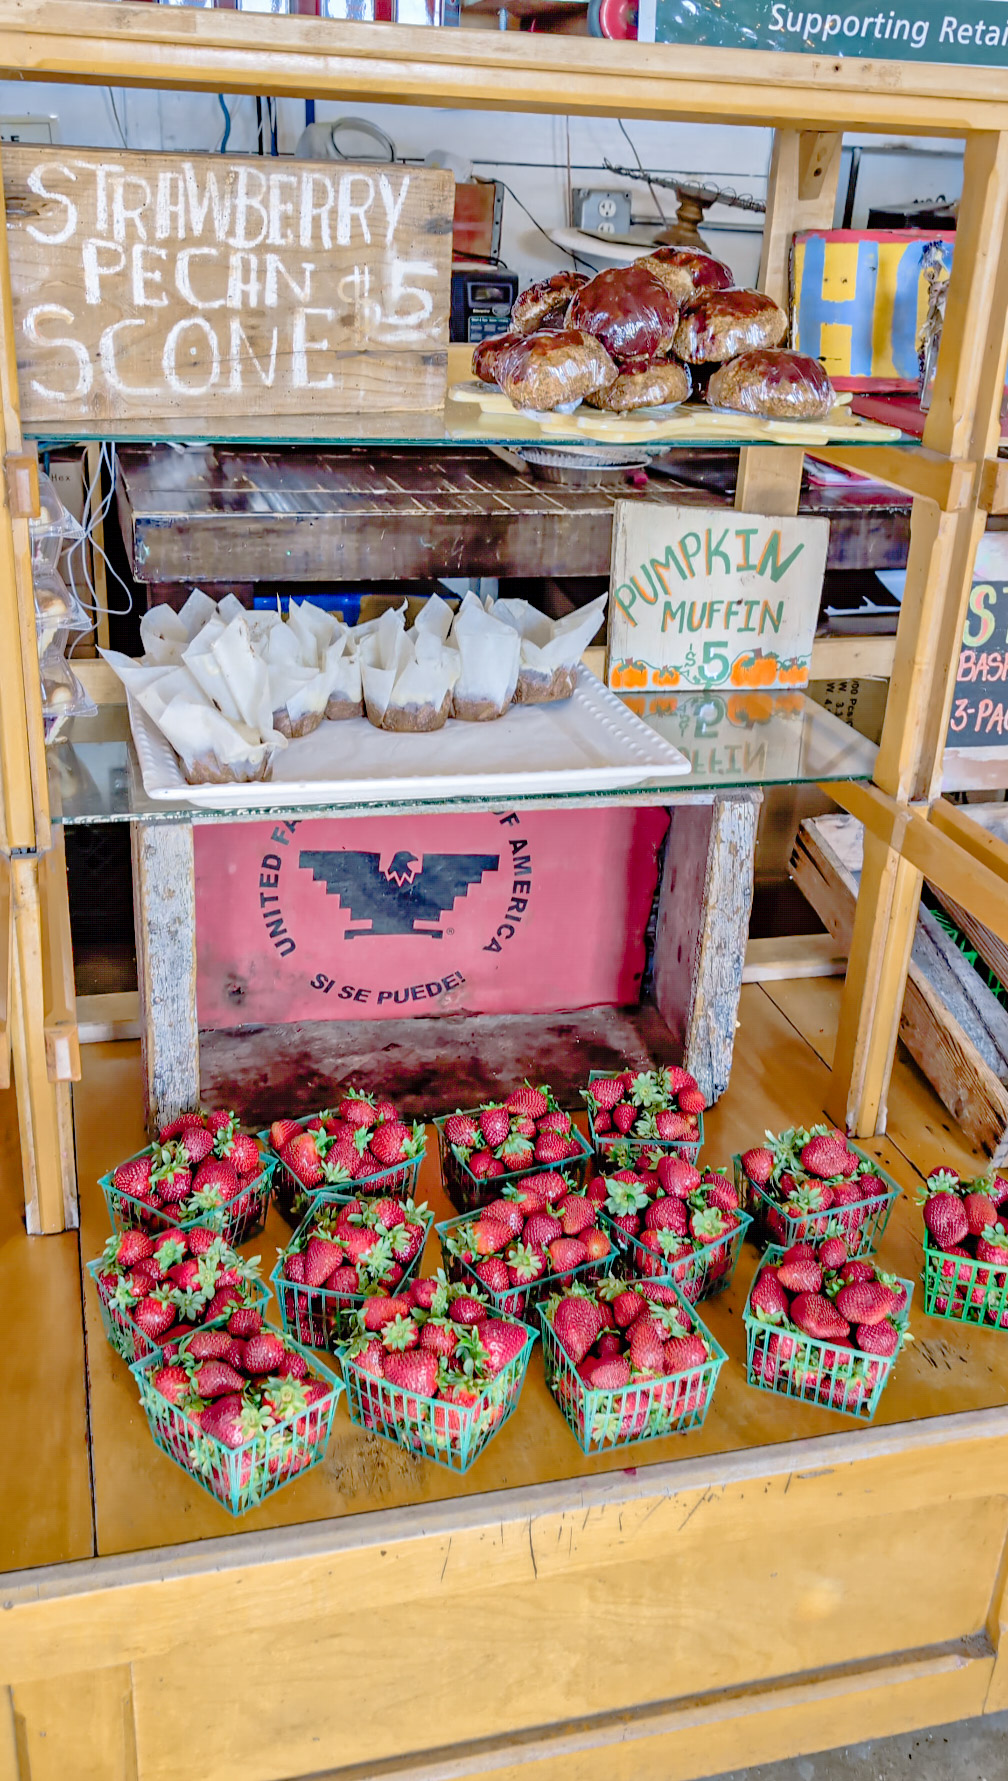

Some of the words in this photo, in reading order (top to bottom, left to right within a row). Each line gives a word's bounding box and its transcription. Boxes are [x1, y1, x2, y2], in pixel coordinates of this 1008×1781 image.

[768, 3, 930, 48] Supporting
[27, 161, 411, 250] STRAWBERRY
[82, 238, 316, 310] PECAN
[22, 303, 336, 401] SCONE
[614, 528, 805, 627] PUMPKIN
[661, 600, 784, 636] MUFFIN
[963, 584, 1008, 647] S
[491, 811, 520, 827] F
[259, 853, 297, 957] UNITED
[482, 839, 532, 952] AMERICA
[310, 973, 336, 994] SI
[337, 985, 372, 1003] SE
[377, 970, 466, 1005] PUEDE!
